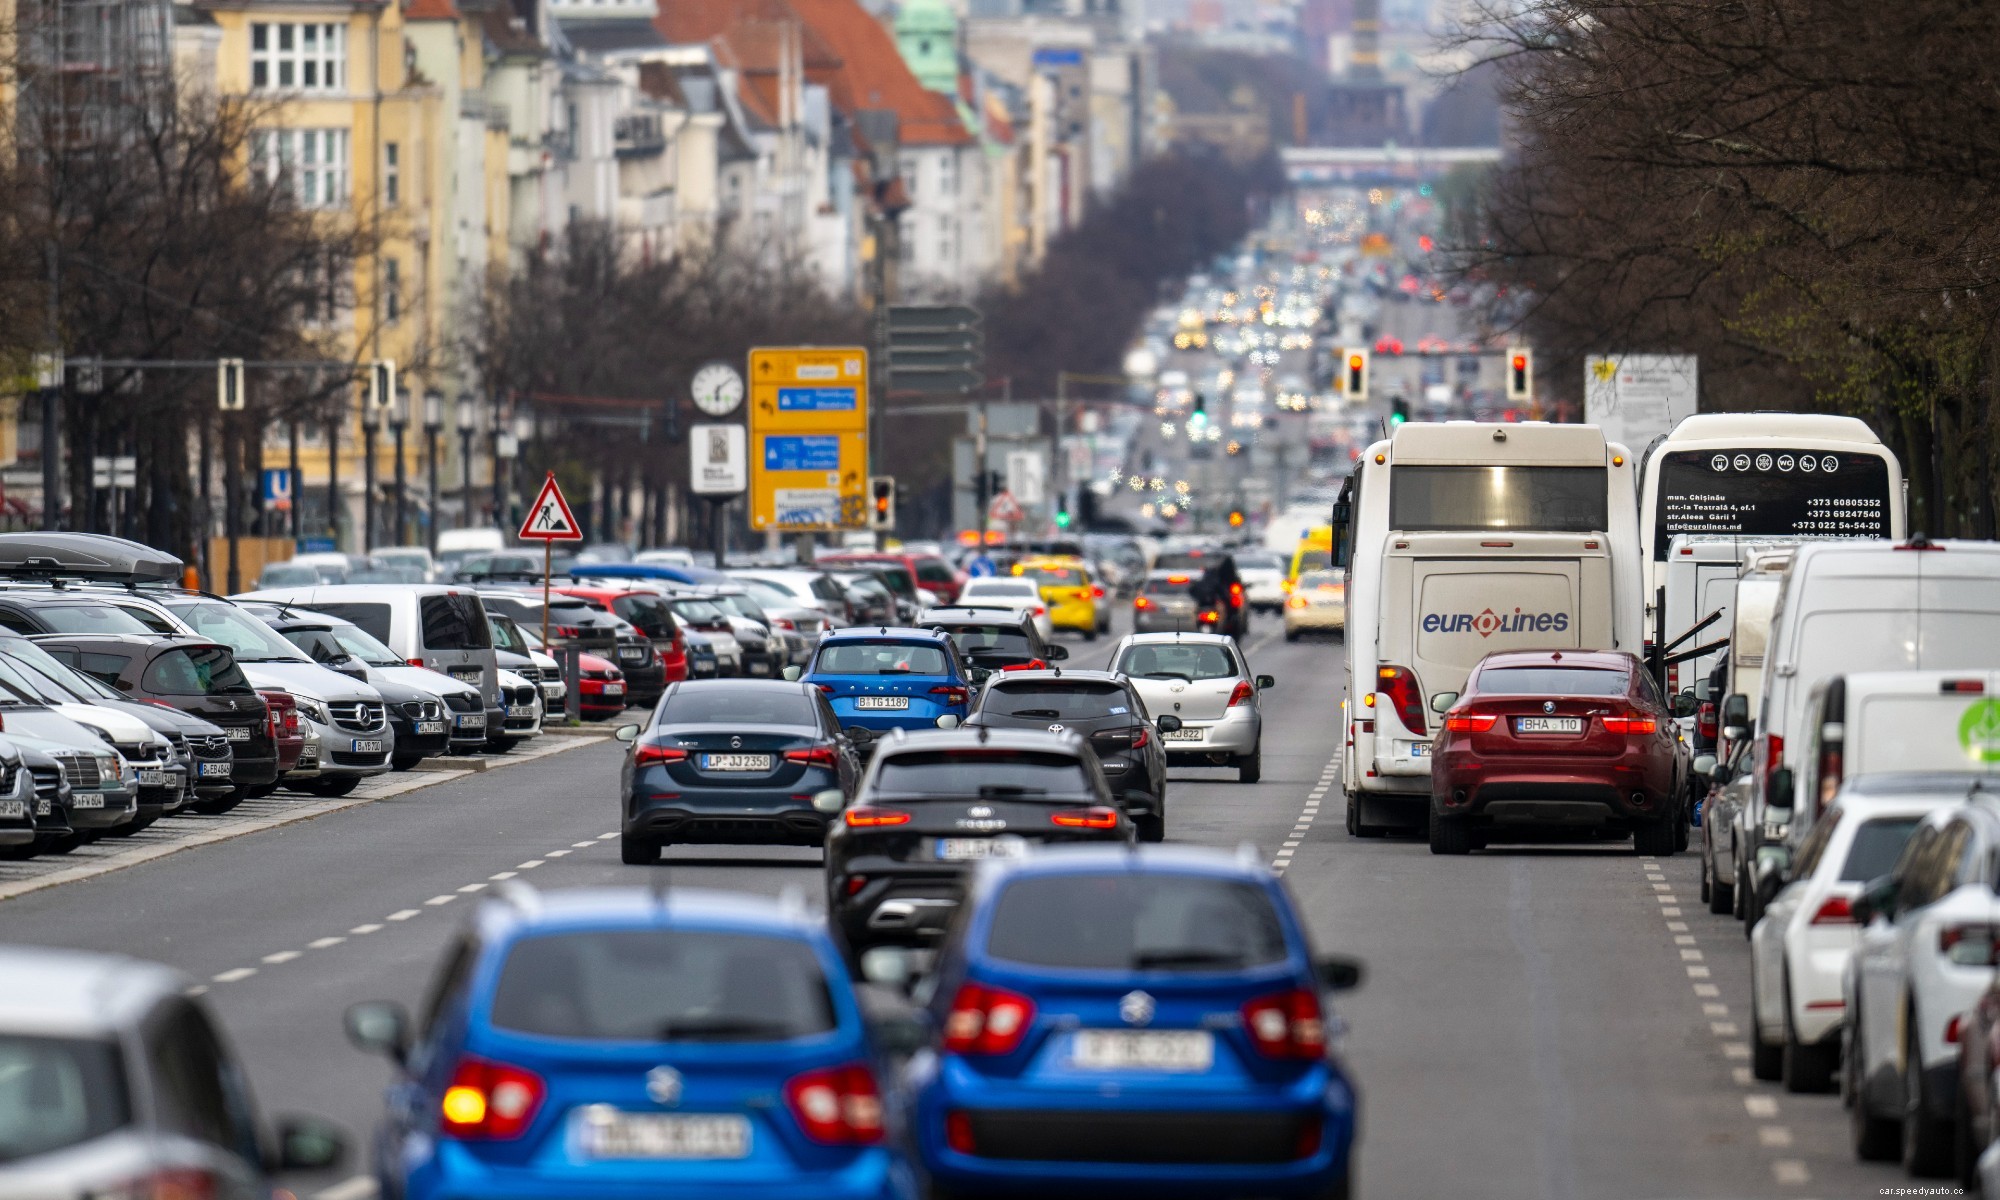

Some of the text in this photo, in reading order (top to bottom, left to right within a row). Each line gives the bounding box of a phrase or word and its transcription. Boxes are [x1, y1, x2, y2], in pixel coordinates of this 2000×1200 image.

[271, 470, 291, 498] U
[1833, 499, 1881, 507] 60805352
[1807, 510, 1881, 518] +373 69247540
[1667, 523, 1742, 531] info@eurolines.md
[1792, 521, 1881, 529] +373 022 54-54-20
[859, 697, 908, 707] B TG 1189
[1524, 719, 1577, 730] BHA 110
[1170, 730, 1182, 738] RJ
[1184, 730, 1199, 738] 822
[709, 754, 769, 766] LP JJ 2358
